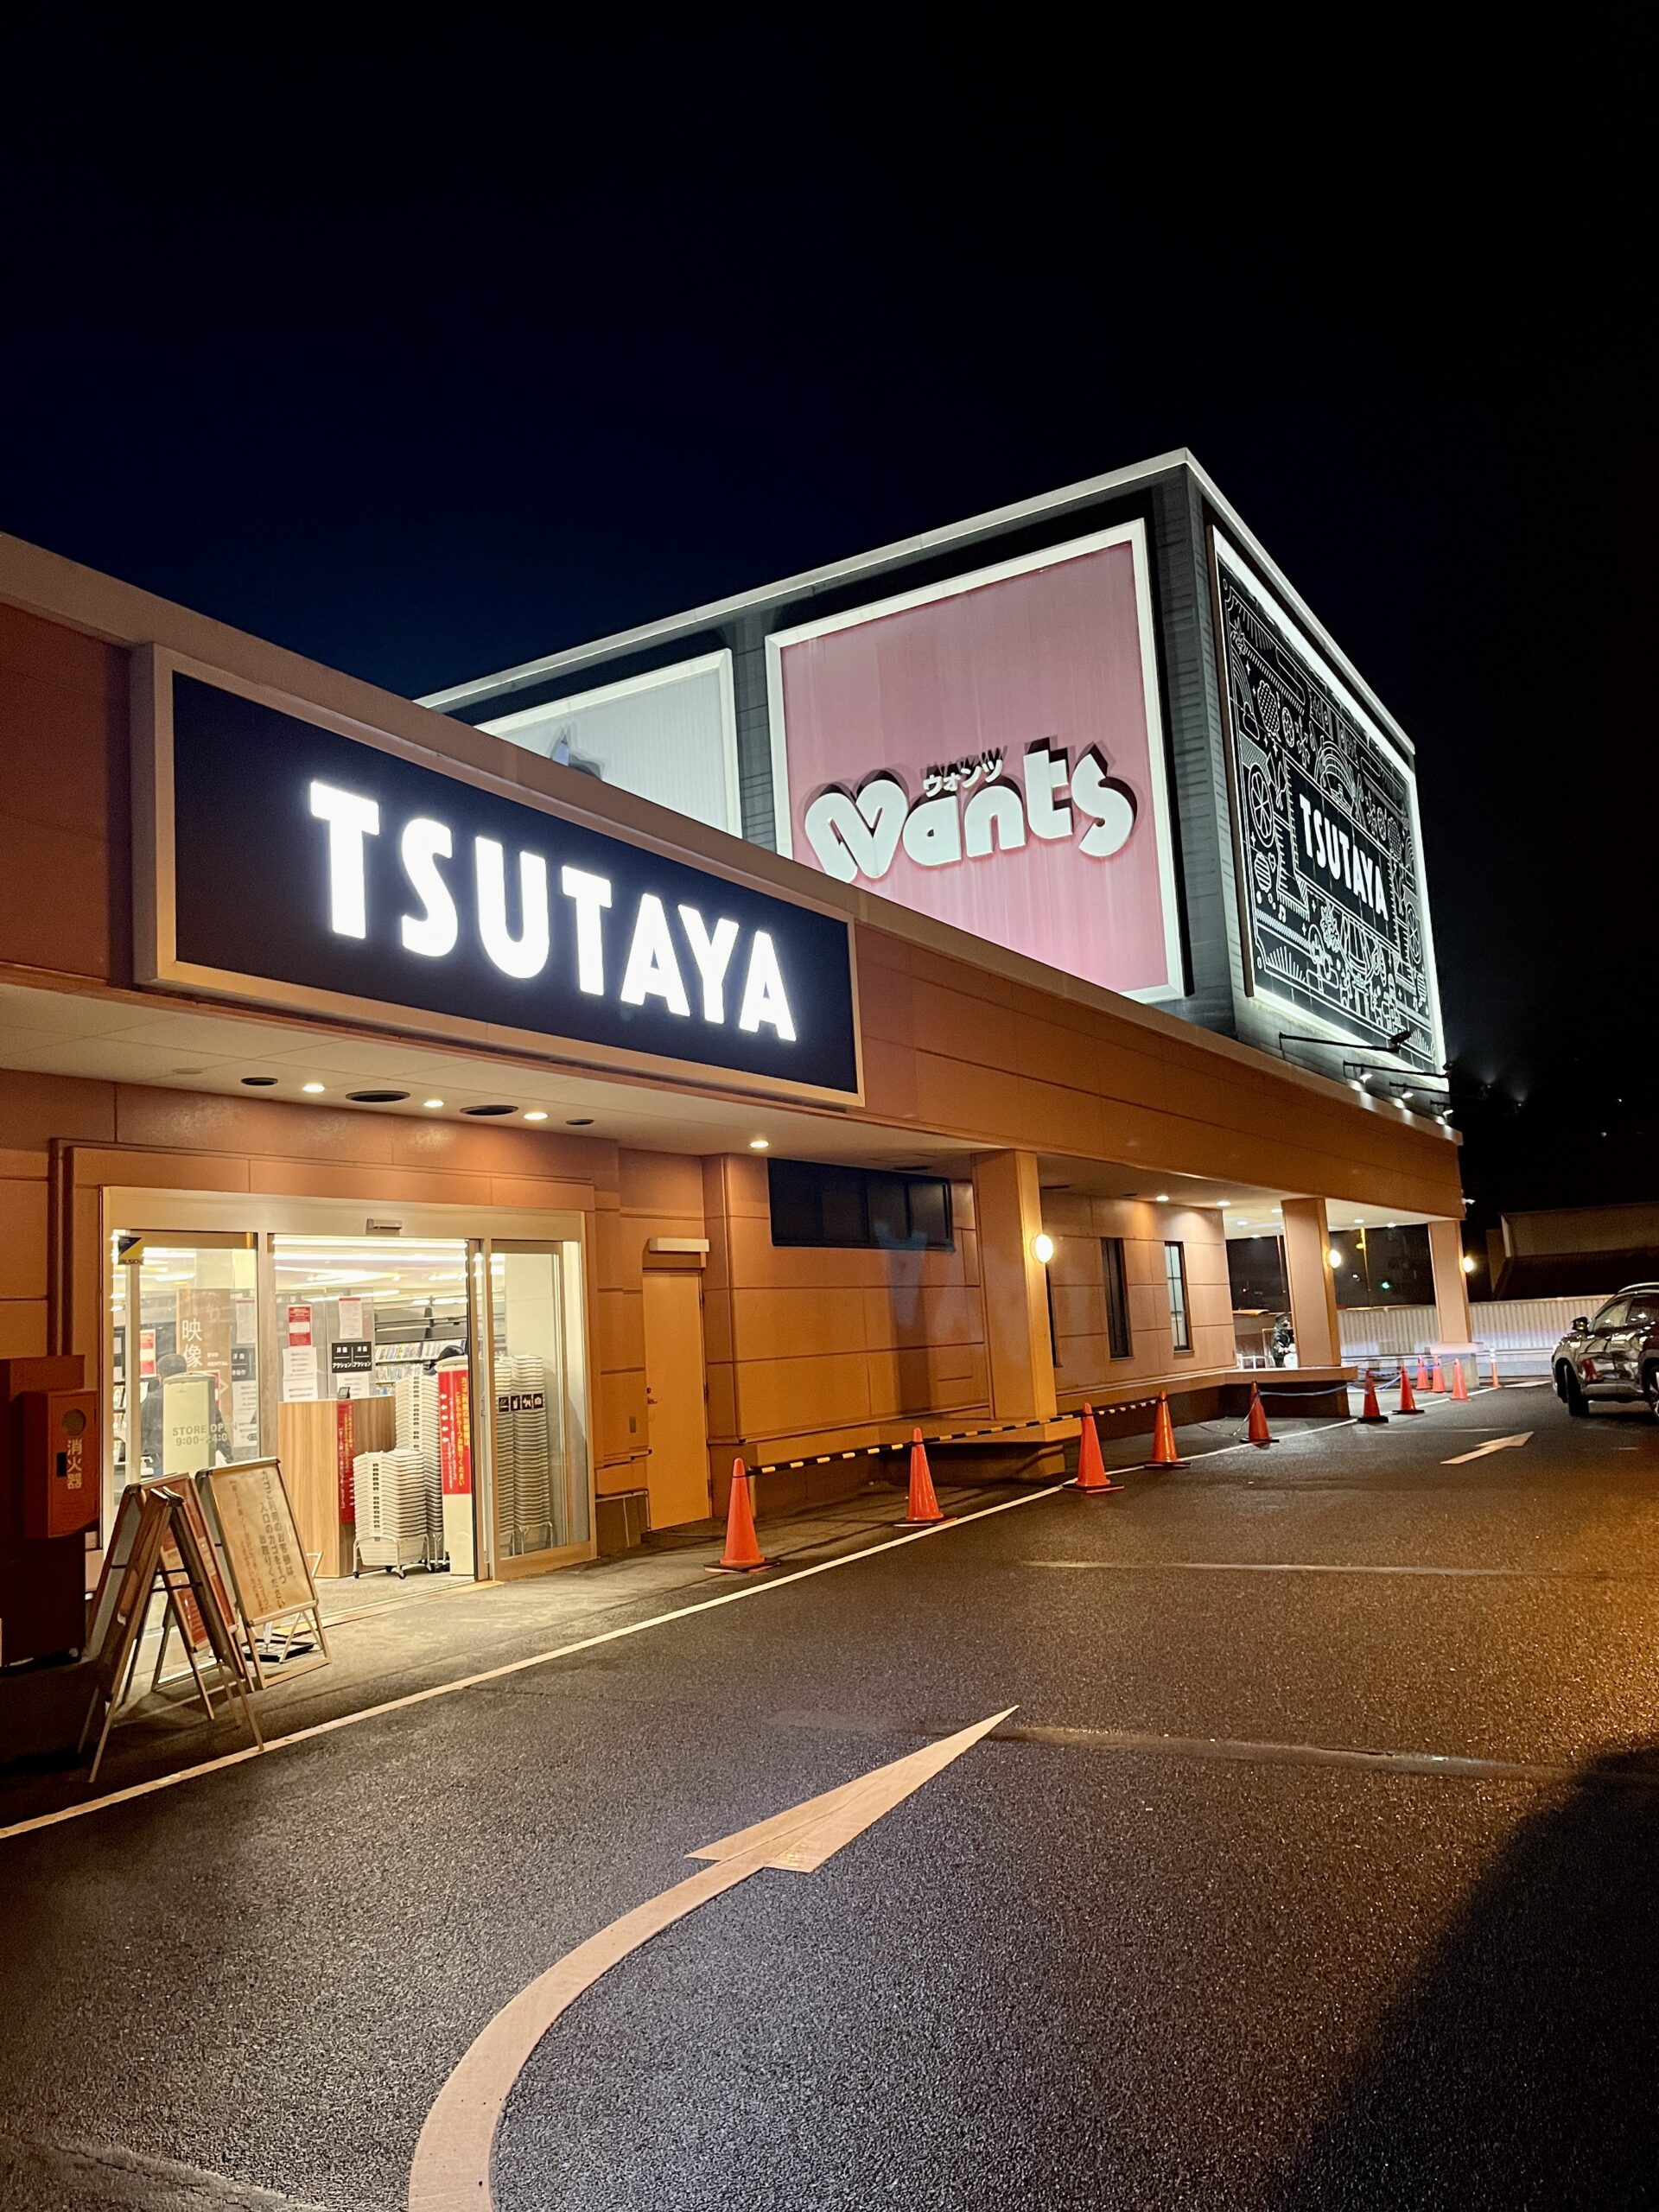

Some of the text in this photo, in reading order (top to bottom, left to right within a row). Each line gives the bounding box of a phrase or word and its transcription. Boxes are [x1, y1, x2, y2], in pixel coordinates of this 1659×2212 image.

[923, 760, 1003, 798] ウォンツ
[804, 749, 1134, 884] Wants
[1299, 793, 1389, 922] TSUTAYA
[309, 780, 798, 1043] TSUTAYA
[181, 1319, 203, 1369] 映像
[172, 1425, 207, 1436] STORE
[67, 1438, 83, 1491] 消火器
